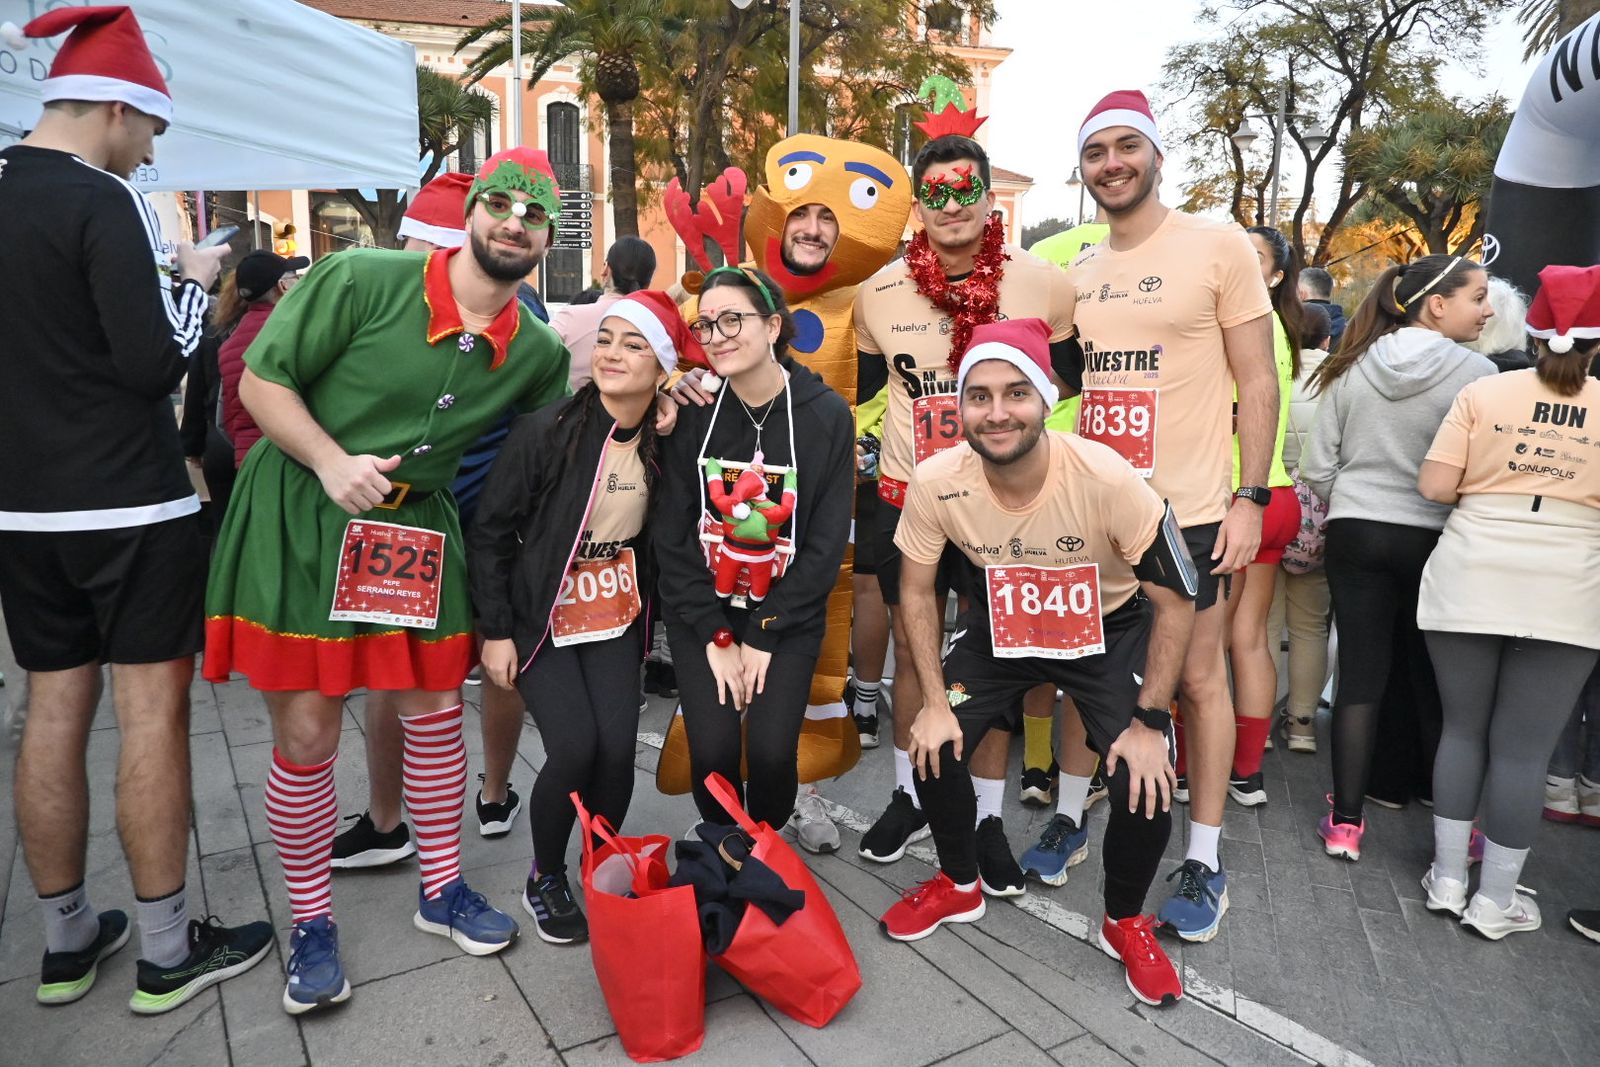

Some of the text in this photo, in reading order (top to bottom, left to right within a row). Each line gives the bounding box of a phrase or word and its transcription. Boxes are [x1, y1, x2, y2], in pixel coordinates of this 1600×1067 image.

[1133, 296, 1162, 305] HUELVA
[891, 323, 927, 333] Huelva
[1083, 404, 1150, 438] 1839
[1532, 402, 1587, 428] RUN
[1518, 463, 1576, 480] ONUPOLIS
[962, 540, 1000, 555] Huelva
[1024, 549, 1047, 557] HUELVA
[349, 539, 438, 583] 1525
[1055, 555, 1090, 564] HUELVA
[994, 569, 1007, 578] 5K
[383, 579, 400, 587] PEPE
[556, 563, 632, 605] 2096
[357, 585, 421, 599] SERRANO REYES
[996, 582, 1092, 618] 1840
